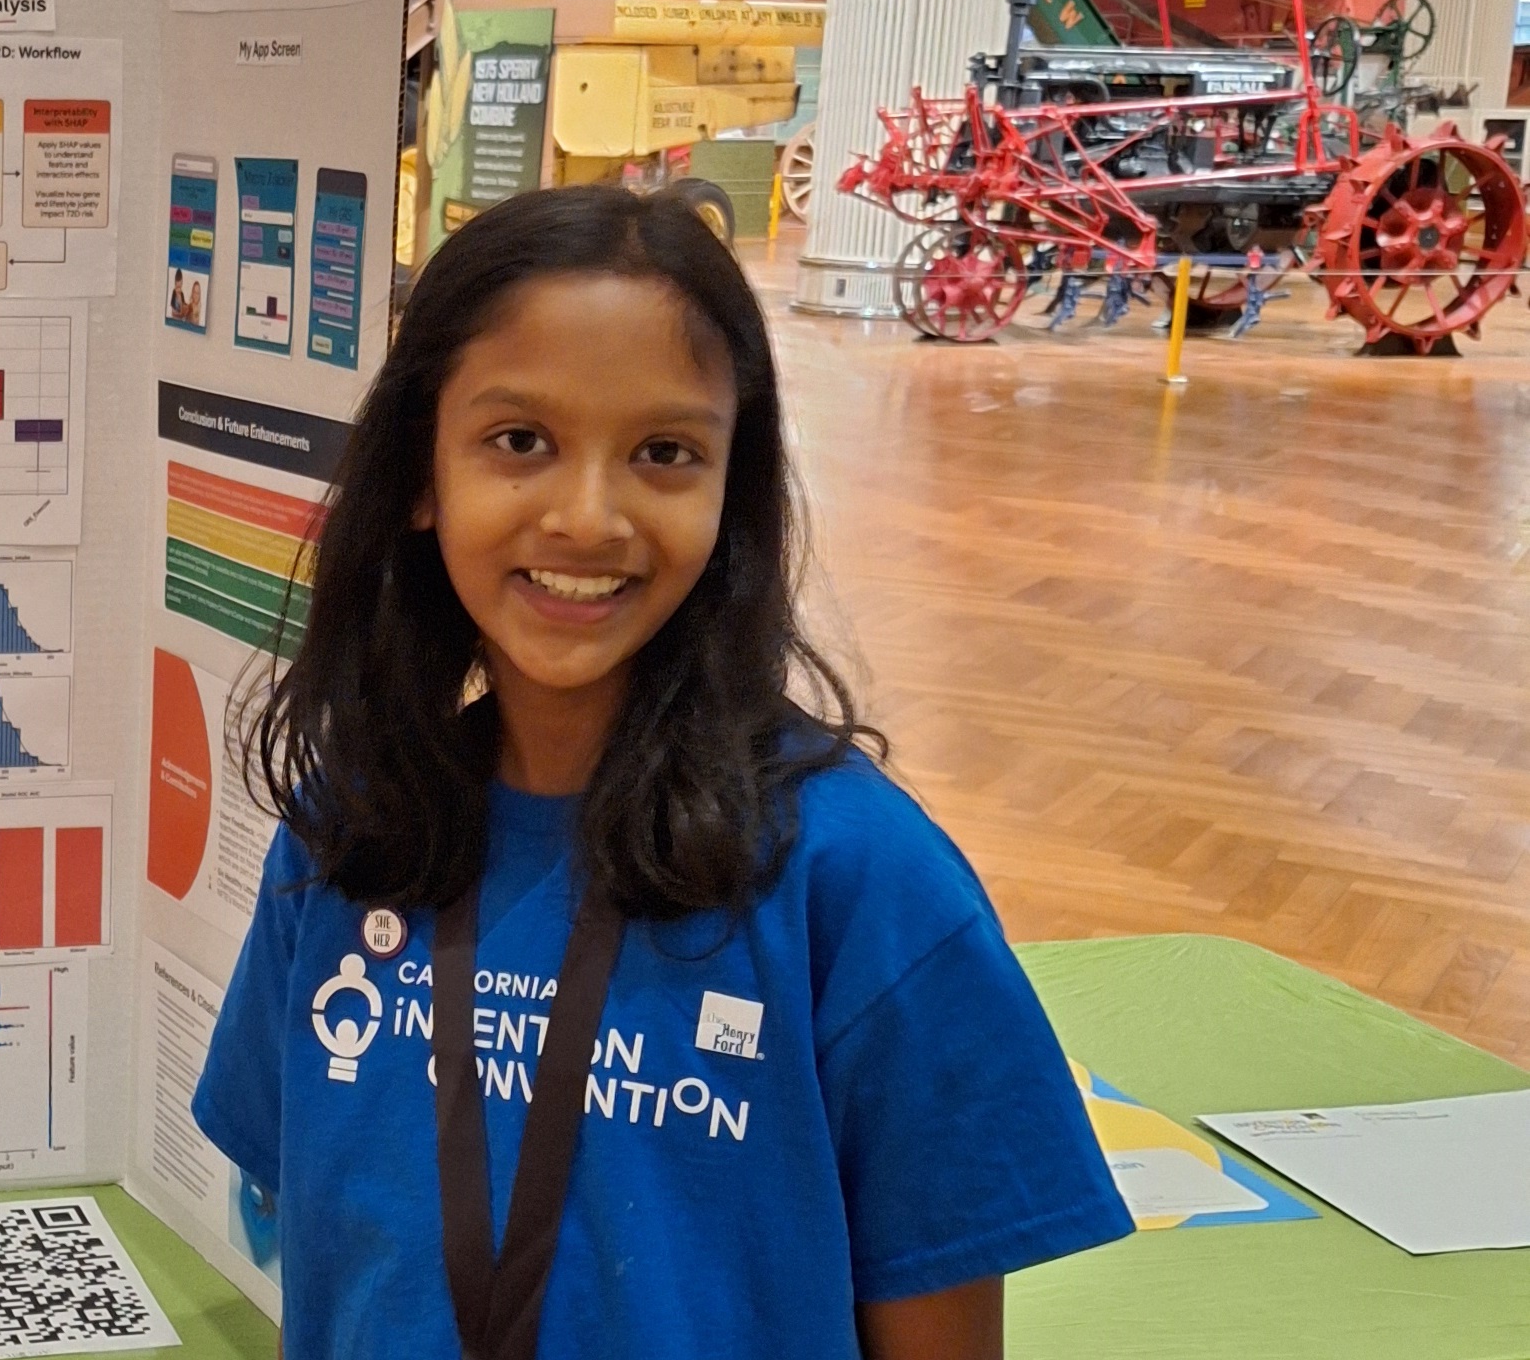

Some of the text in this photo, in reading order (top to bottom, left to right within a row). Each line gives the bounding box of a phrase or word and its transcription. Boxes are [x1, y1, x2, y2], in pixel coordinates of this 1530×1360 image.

[19, 46, 81, 60] Workflow
[239, 40, 301, 60] My App Screen
[496, 82, 542, 104] HOLLAND
[1207, 81, 1266, 93] FARMALL
[44, 118, 88, 128] with SHAP
[179, 406, 217, 429] Conclusion
[224, 418, 250, 438] Future
[250, 423, 311, 452] Enhancements
[375, 915, 391, 929] SHE
[374, 933, 390, 947] HER
[723, 1023, 755, 1044] Henry
[713, 1034, 744, 1055] Ford
[68, 1056, 76, 1084] Feature
